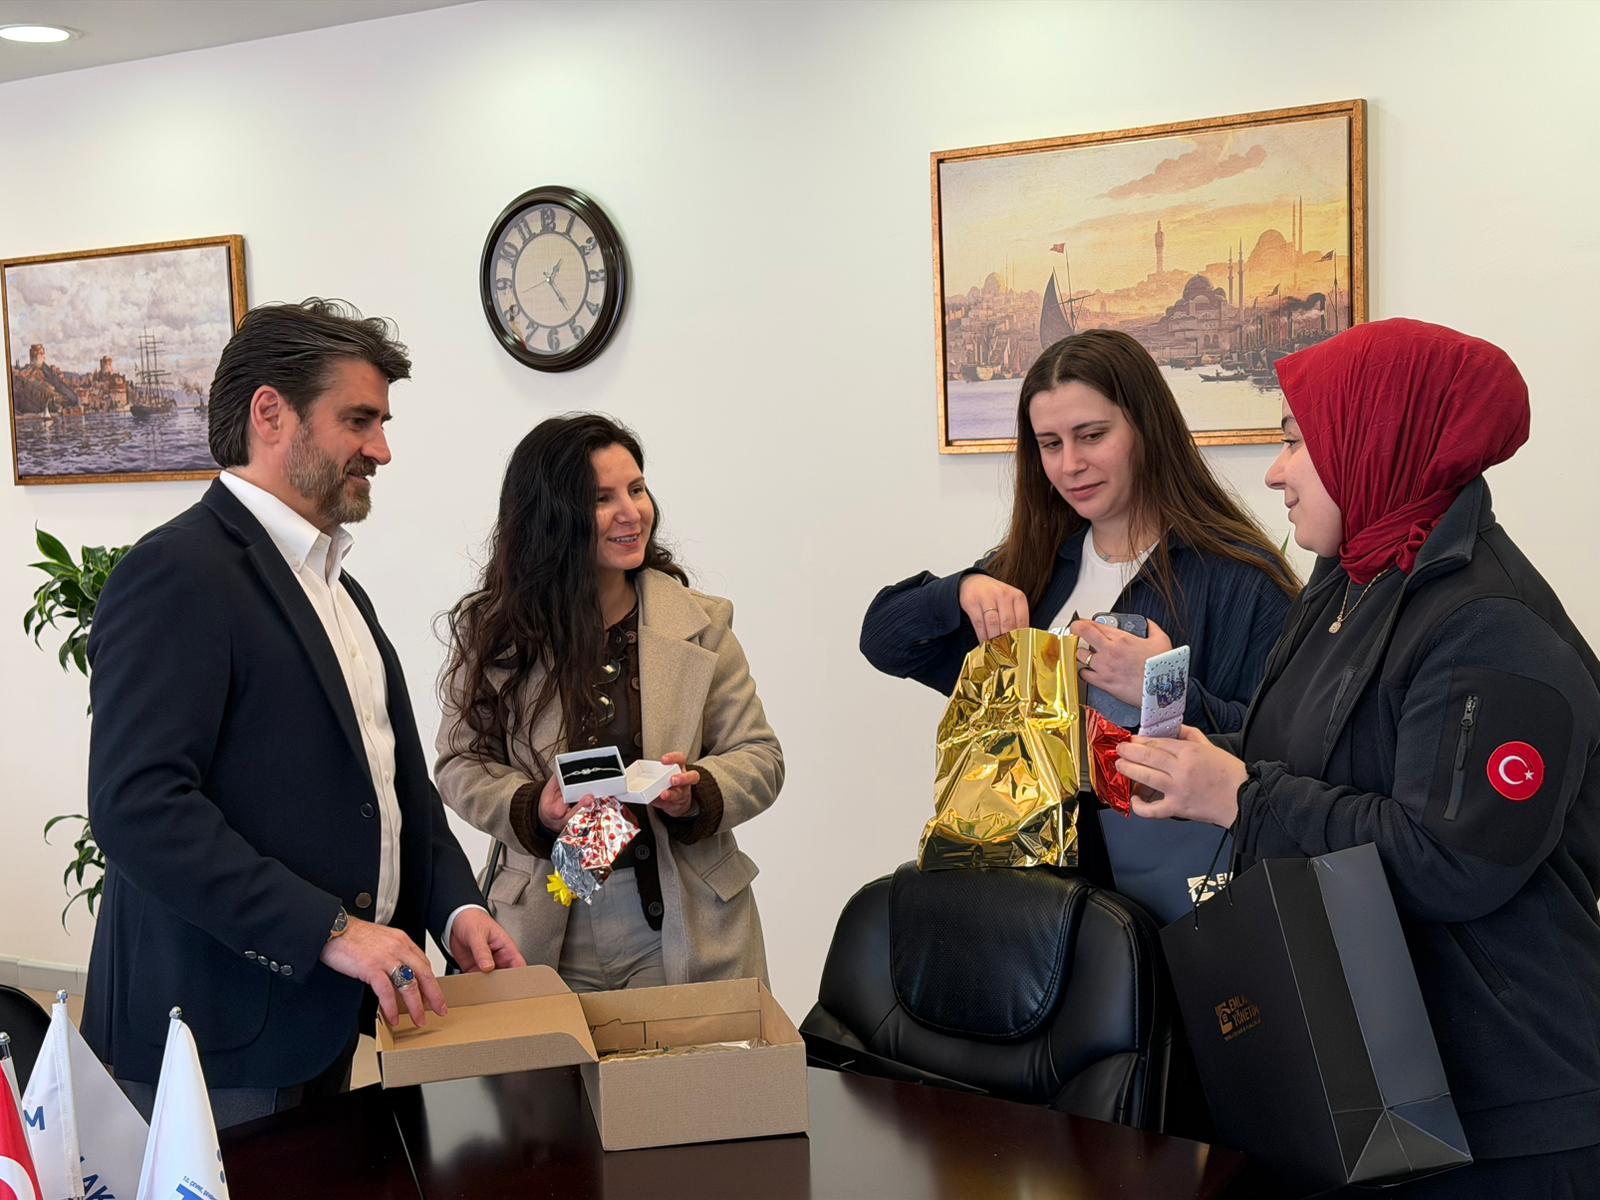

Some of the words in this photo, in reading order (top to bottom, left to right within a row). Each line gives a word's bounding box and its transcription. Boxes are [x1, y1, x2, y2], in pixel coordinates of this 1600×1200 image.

[514, 217, 536, 244] 11
[540, 207, 556, 232] 12
[563, 213, 576, 239] 1
[498, 242, 518, 268] 10
[579, 236, 598, 256] 2
[495, 277, 513, 291] 9
[588, 268, 606, 283] 3
[504, 304, 521, 322] 8
[584, 300, 600, 317] 4
[525, 318, 539, 343] 7
[547, 327, 560, 351] 6
[569, 318, 585, 341] 5
